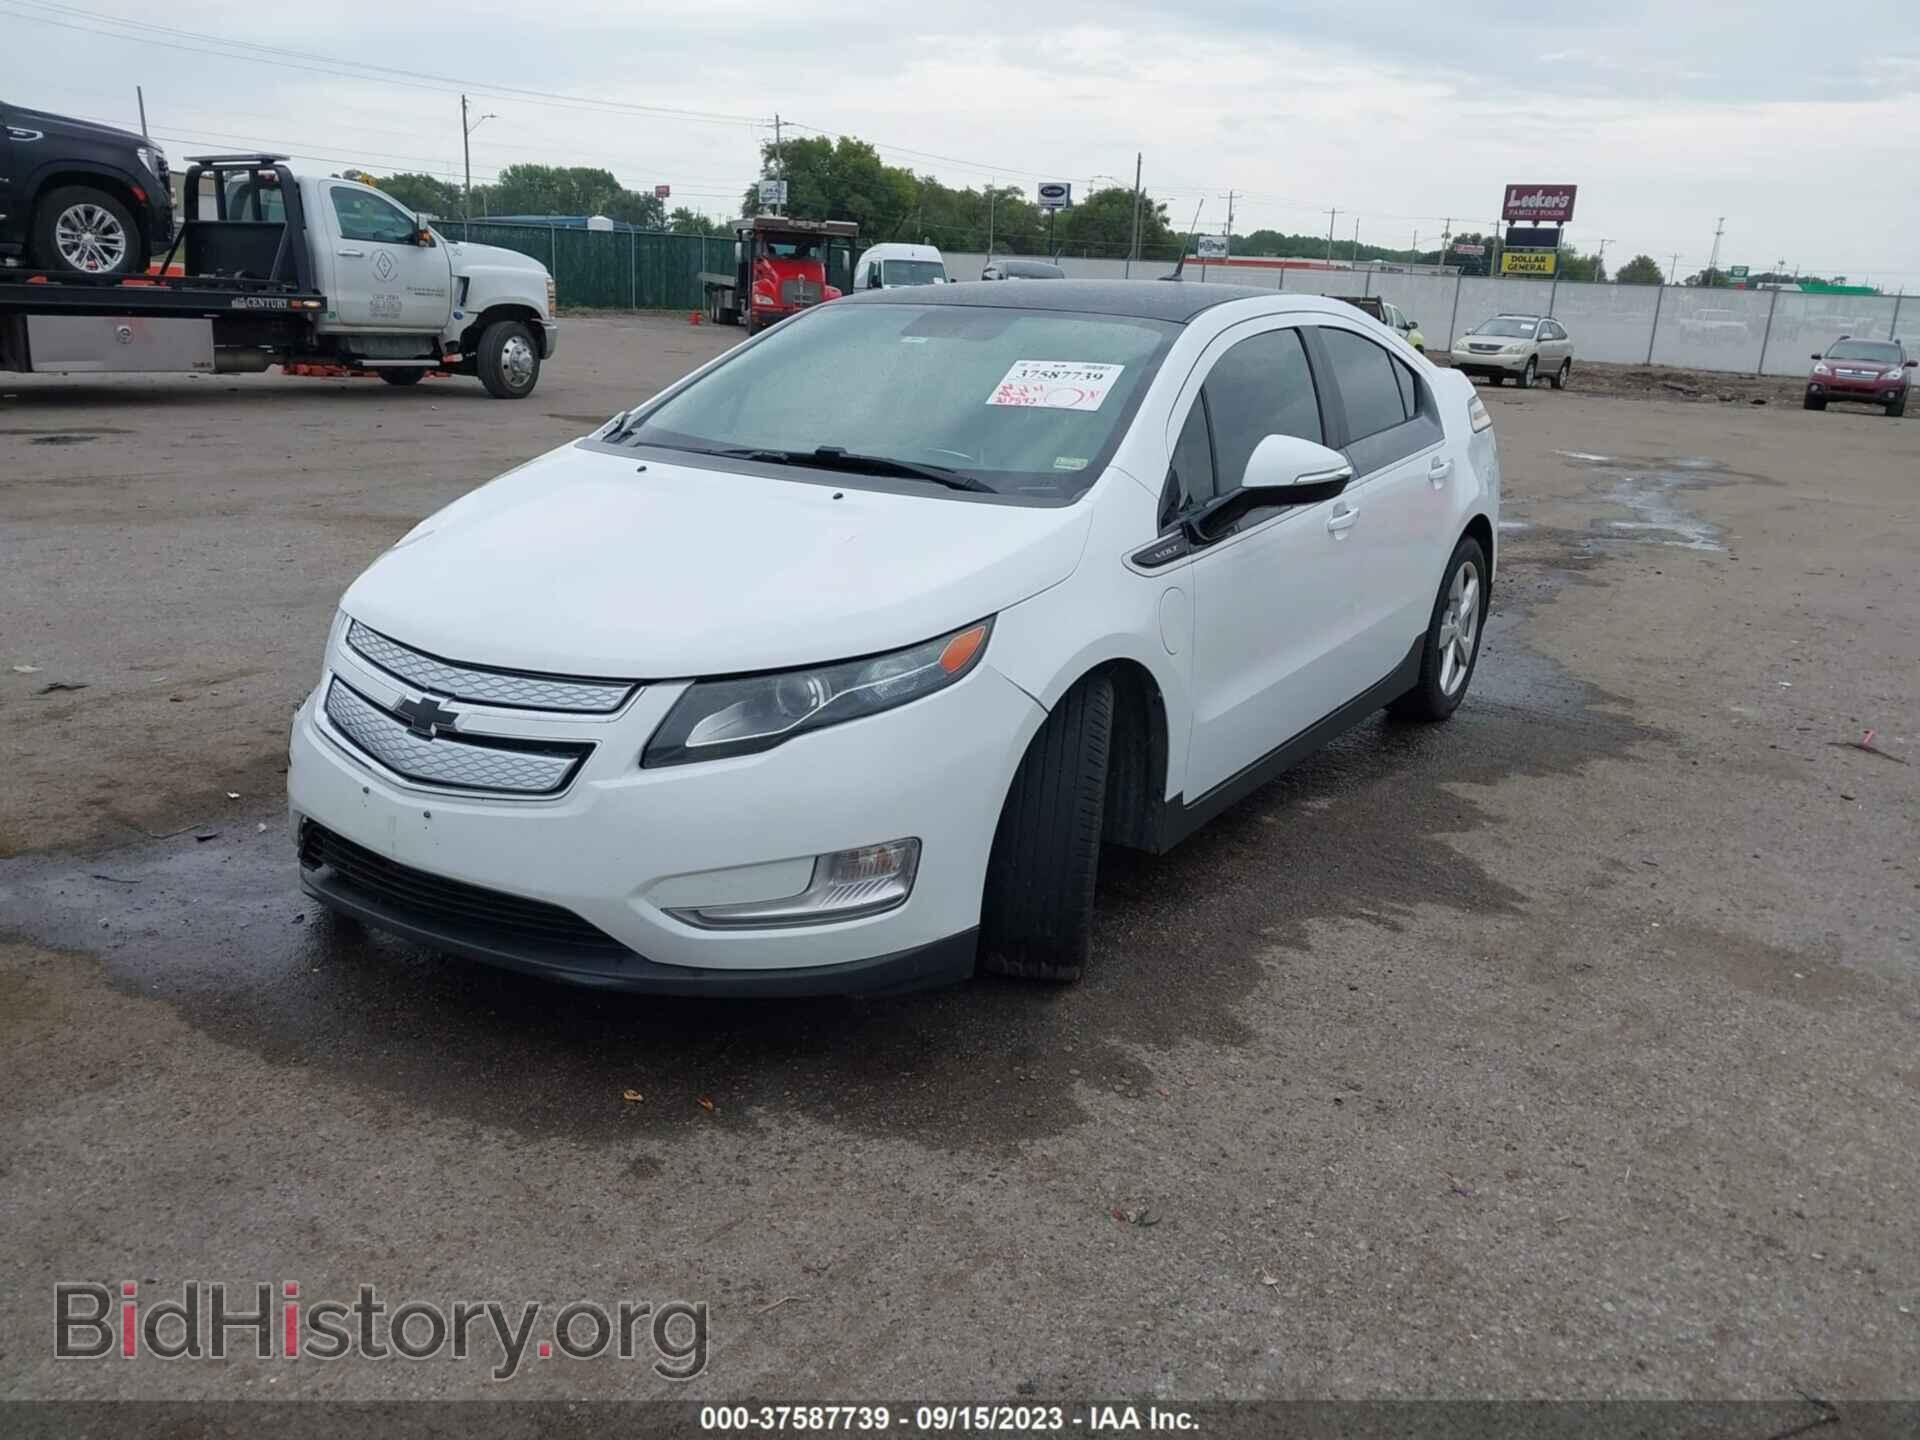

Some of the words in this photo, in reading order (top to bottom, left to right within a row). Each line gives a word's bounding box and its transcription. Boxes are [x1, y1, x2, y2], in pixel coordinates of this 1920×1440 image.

[1507, 189, 1570, 208] Leeker's
[1511, 255, 1547, 263] DOLLAR
[1507, 263, 1547, 272] GENERAL
[246, 297, 287, 309] CENTURY
